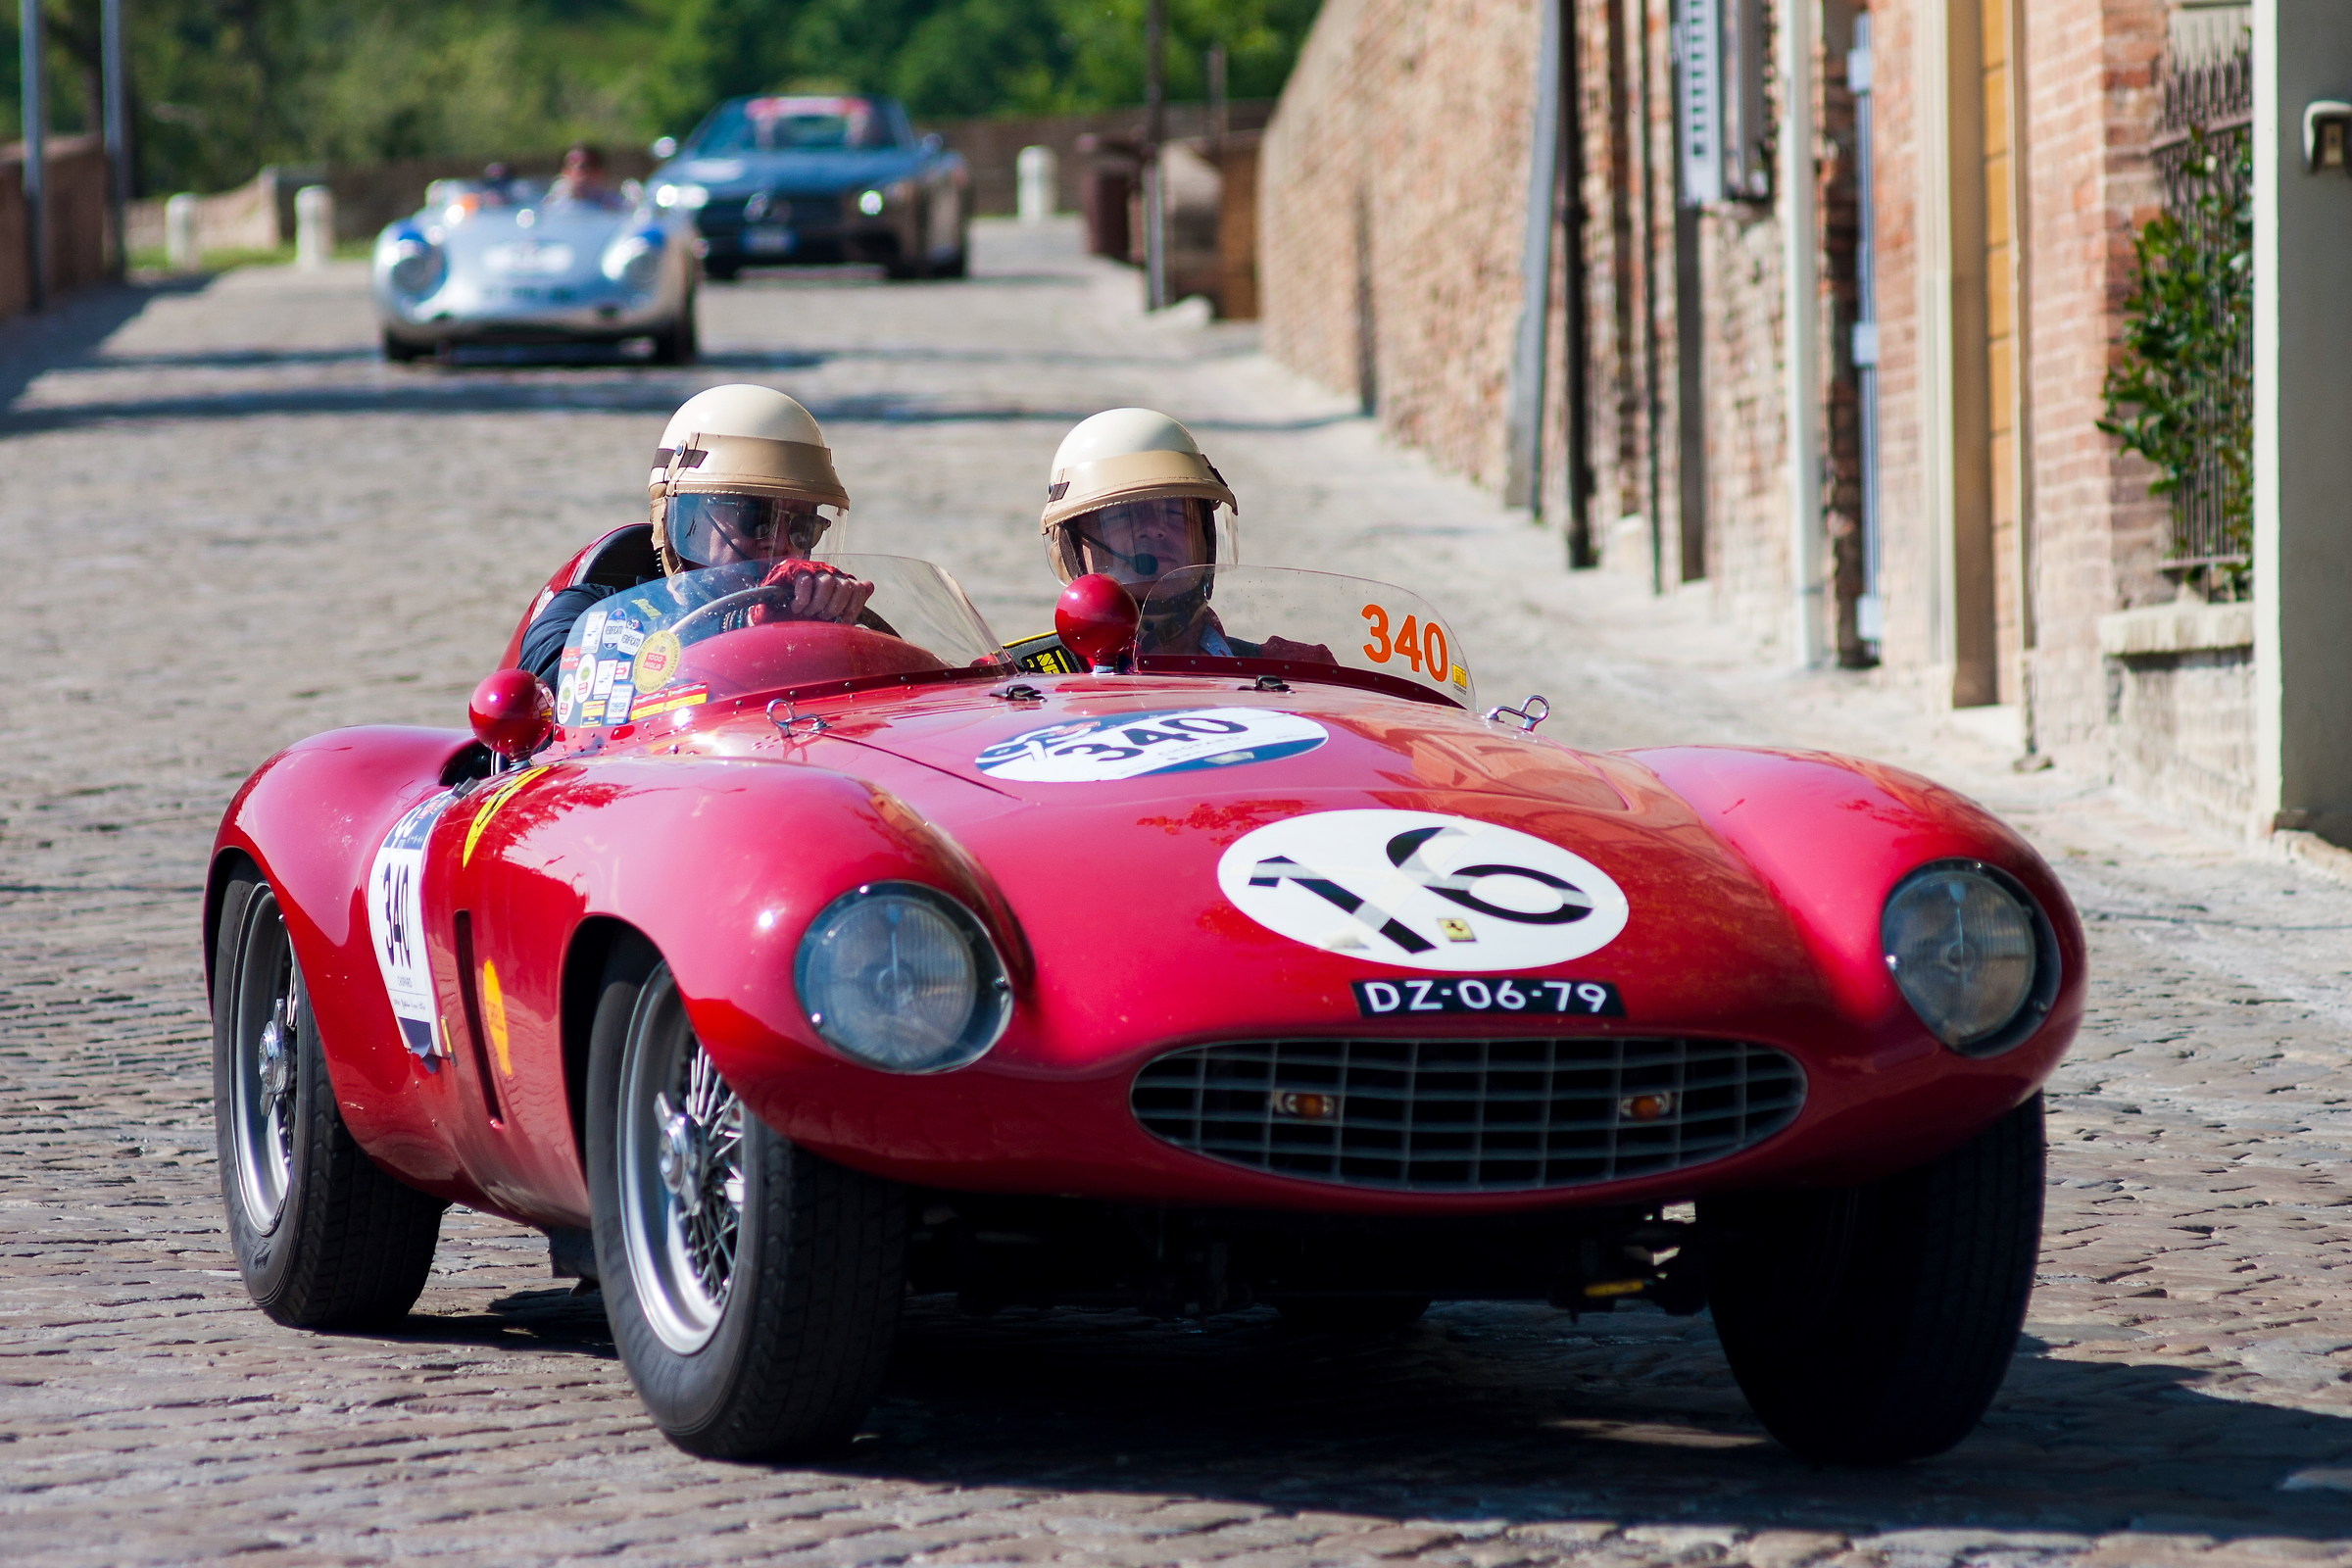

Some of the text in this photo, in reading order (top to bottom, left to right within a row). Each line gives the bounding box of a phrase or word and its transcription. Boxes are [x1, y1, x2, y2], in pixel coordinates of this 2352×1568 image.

[1361, 604, 1448, 683] 340
[1053, 717, 1250, 762] 340
[382, 861, 412, 969] 340
[1248, 825, 1594, 956] 16
[1363, 979, 1609, 1014] DZ-06-79
